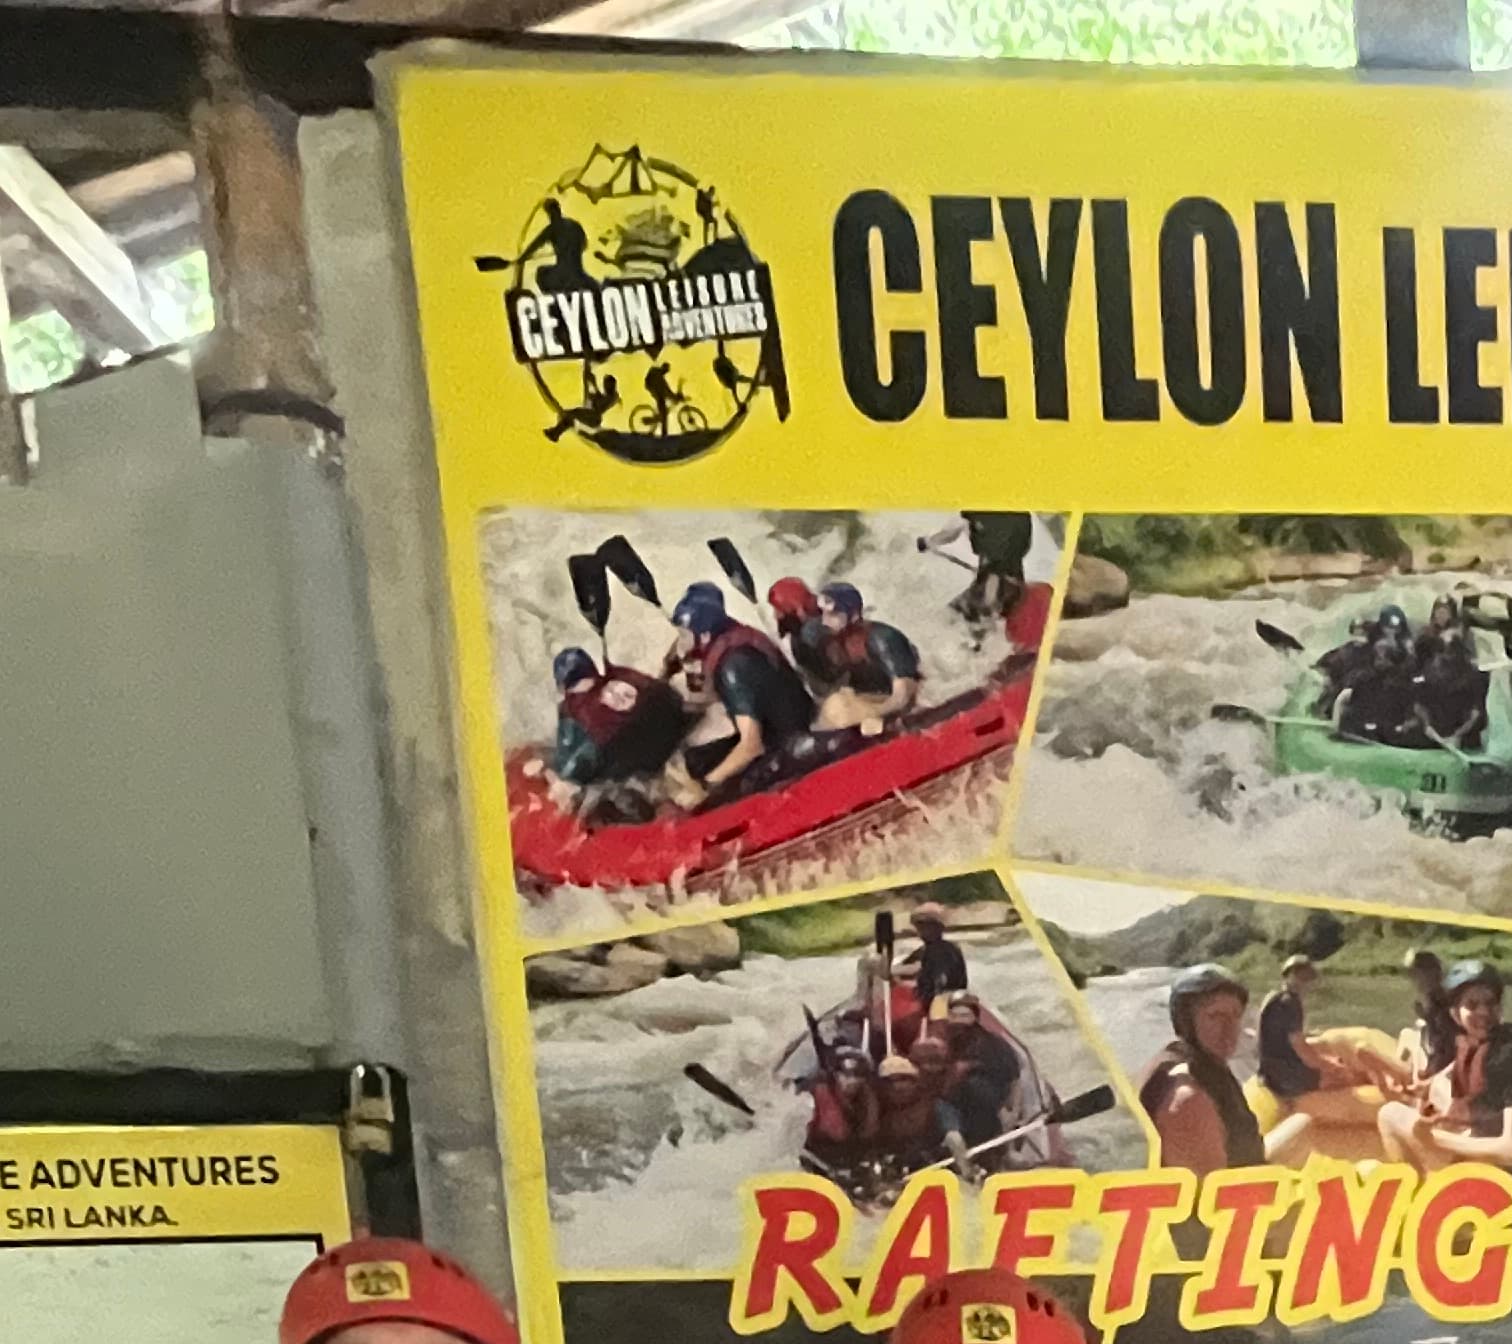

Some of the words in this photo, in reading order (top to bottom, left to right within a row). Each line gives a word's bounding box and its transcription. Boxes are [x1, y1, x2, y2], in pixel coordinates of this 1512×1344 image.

[517, 283, 656, 359] CEYLON
[833, 188, 1343, 426] CEYLON
[30, 1155, 280, 1189] ADVENTURES
[6, 1206, 54, 1230] SRI
